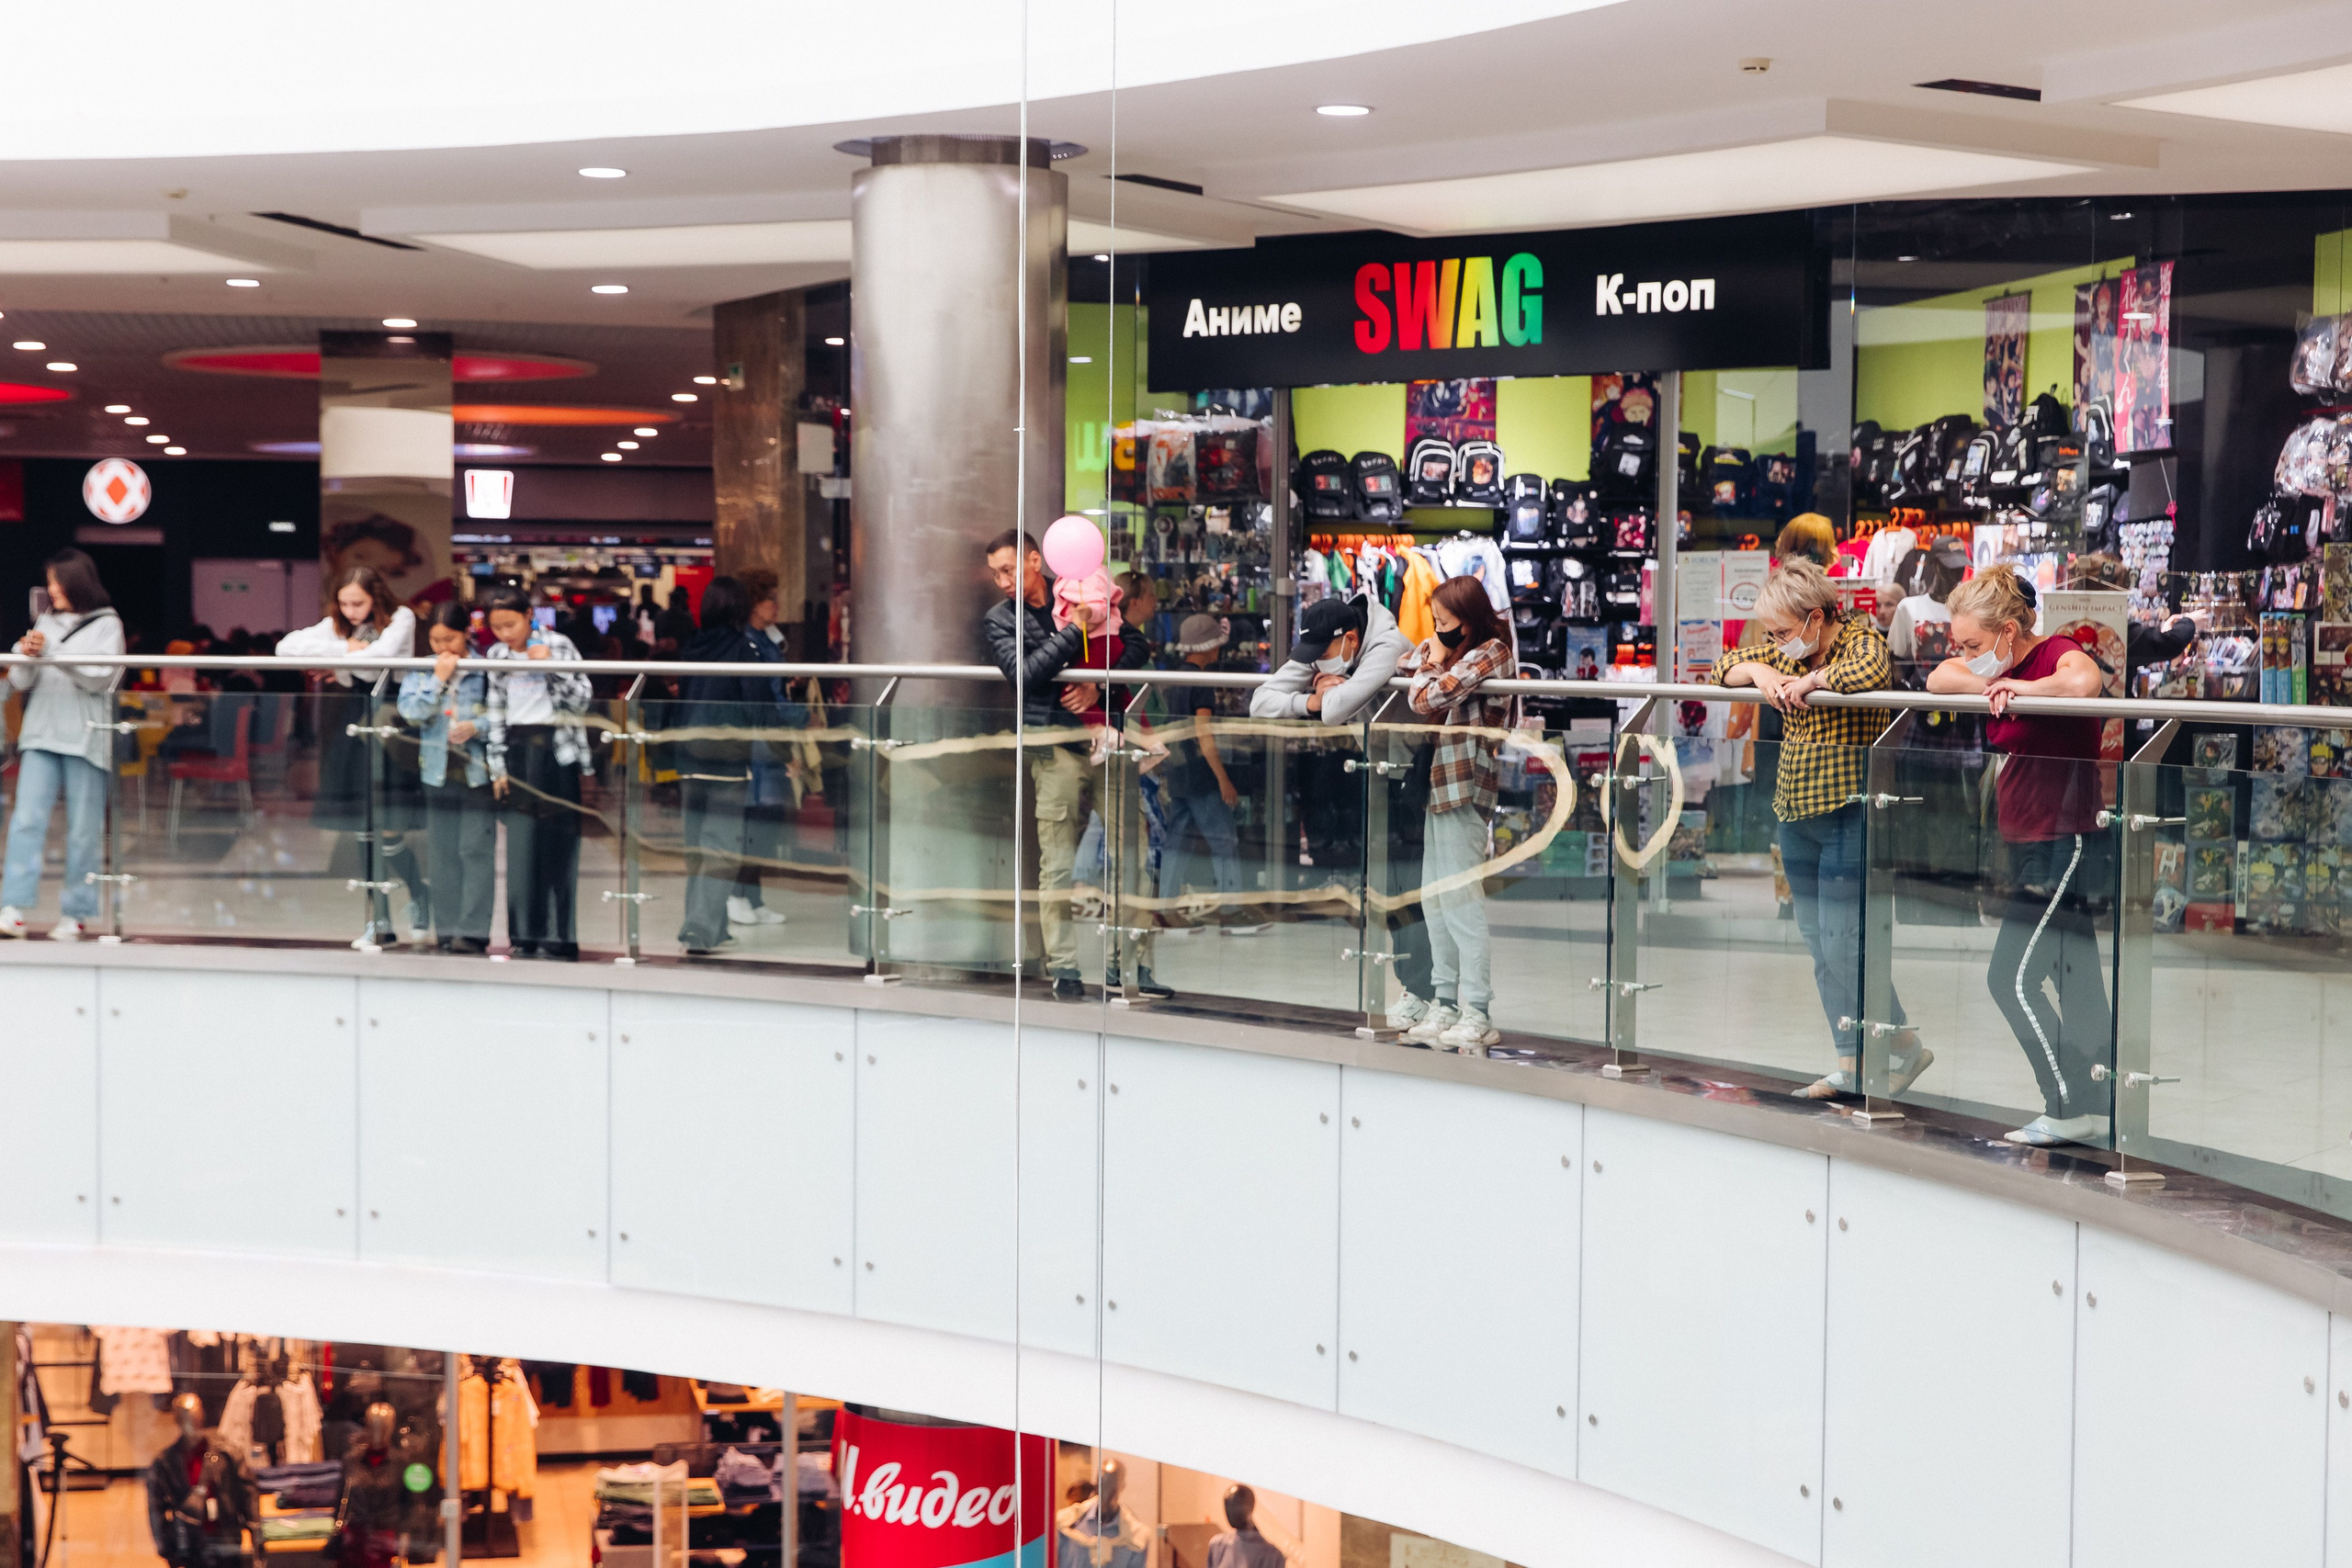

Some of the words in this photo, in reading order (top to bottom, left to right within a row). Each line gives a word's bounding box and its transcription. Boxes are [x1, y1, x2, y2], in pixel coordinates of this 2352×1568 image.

[1353, 253, 1544, 355] SWAG
[1596, 273, 1715, 316] К-поп
[1182, 299, 1303, 338] Аниме
